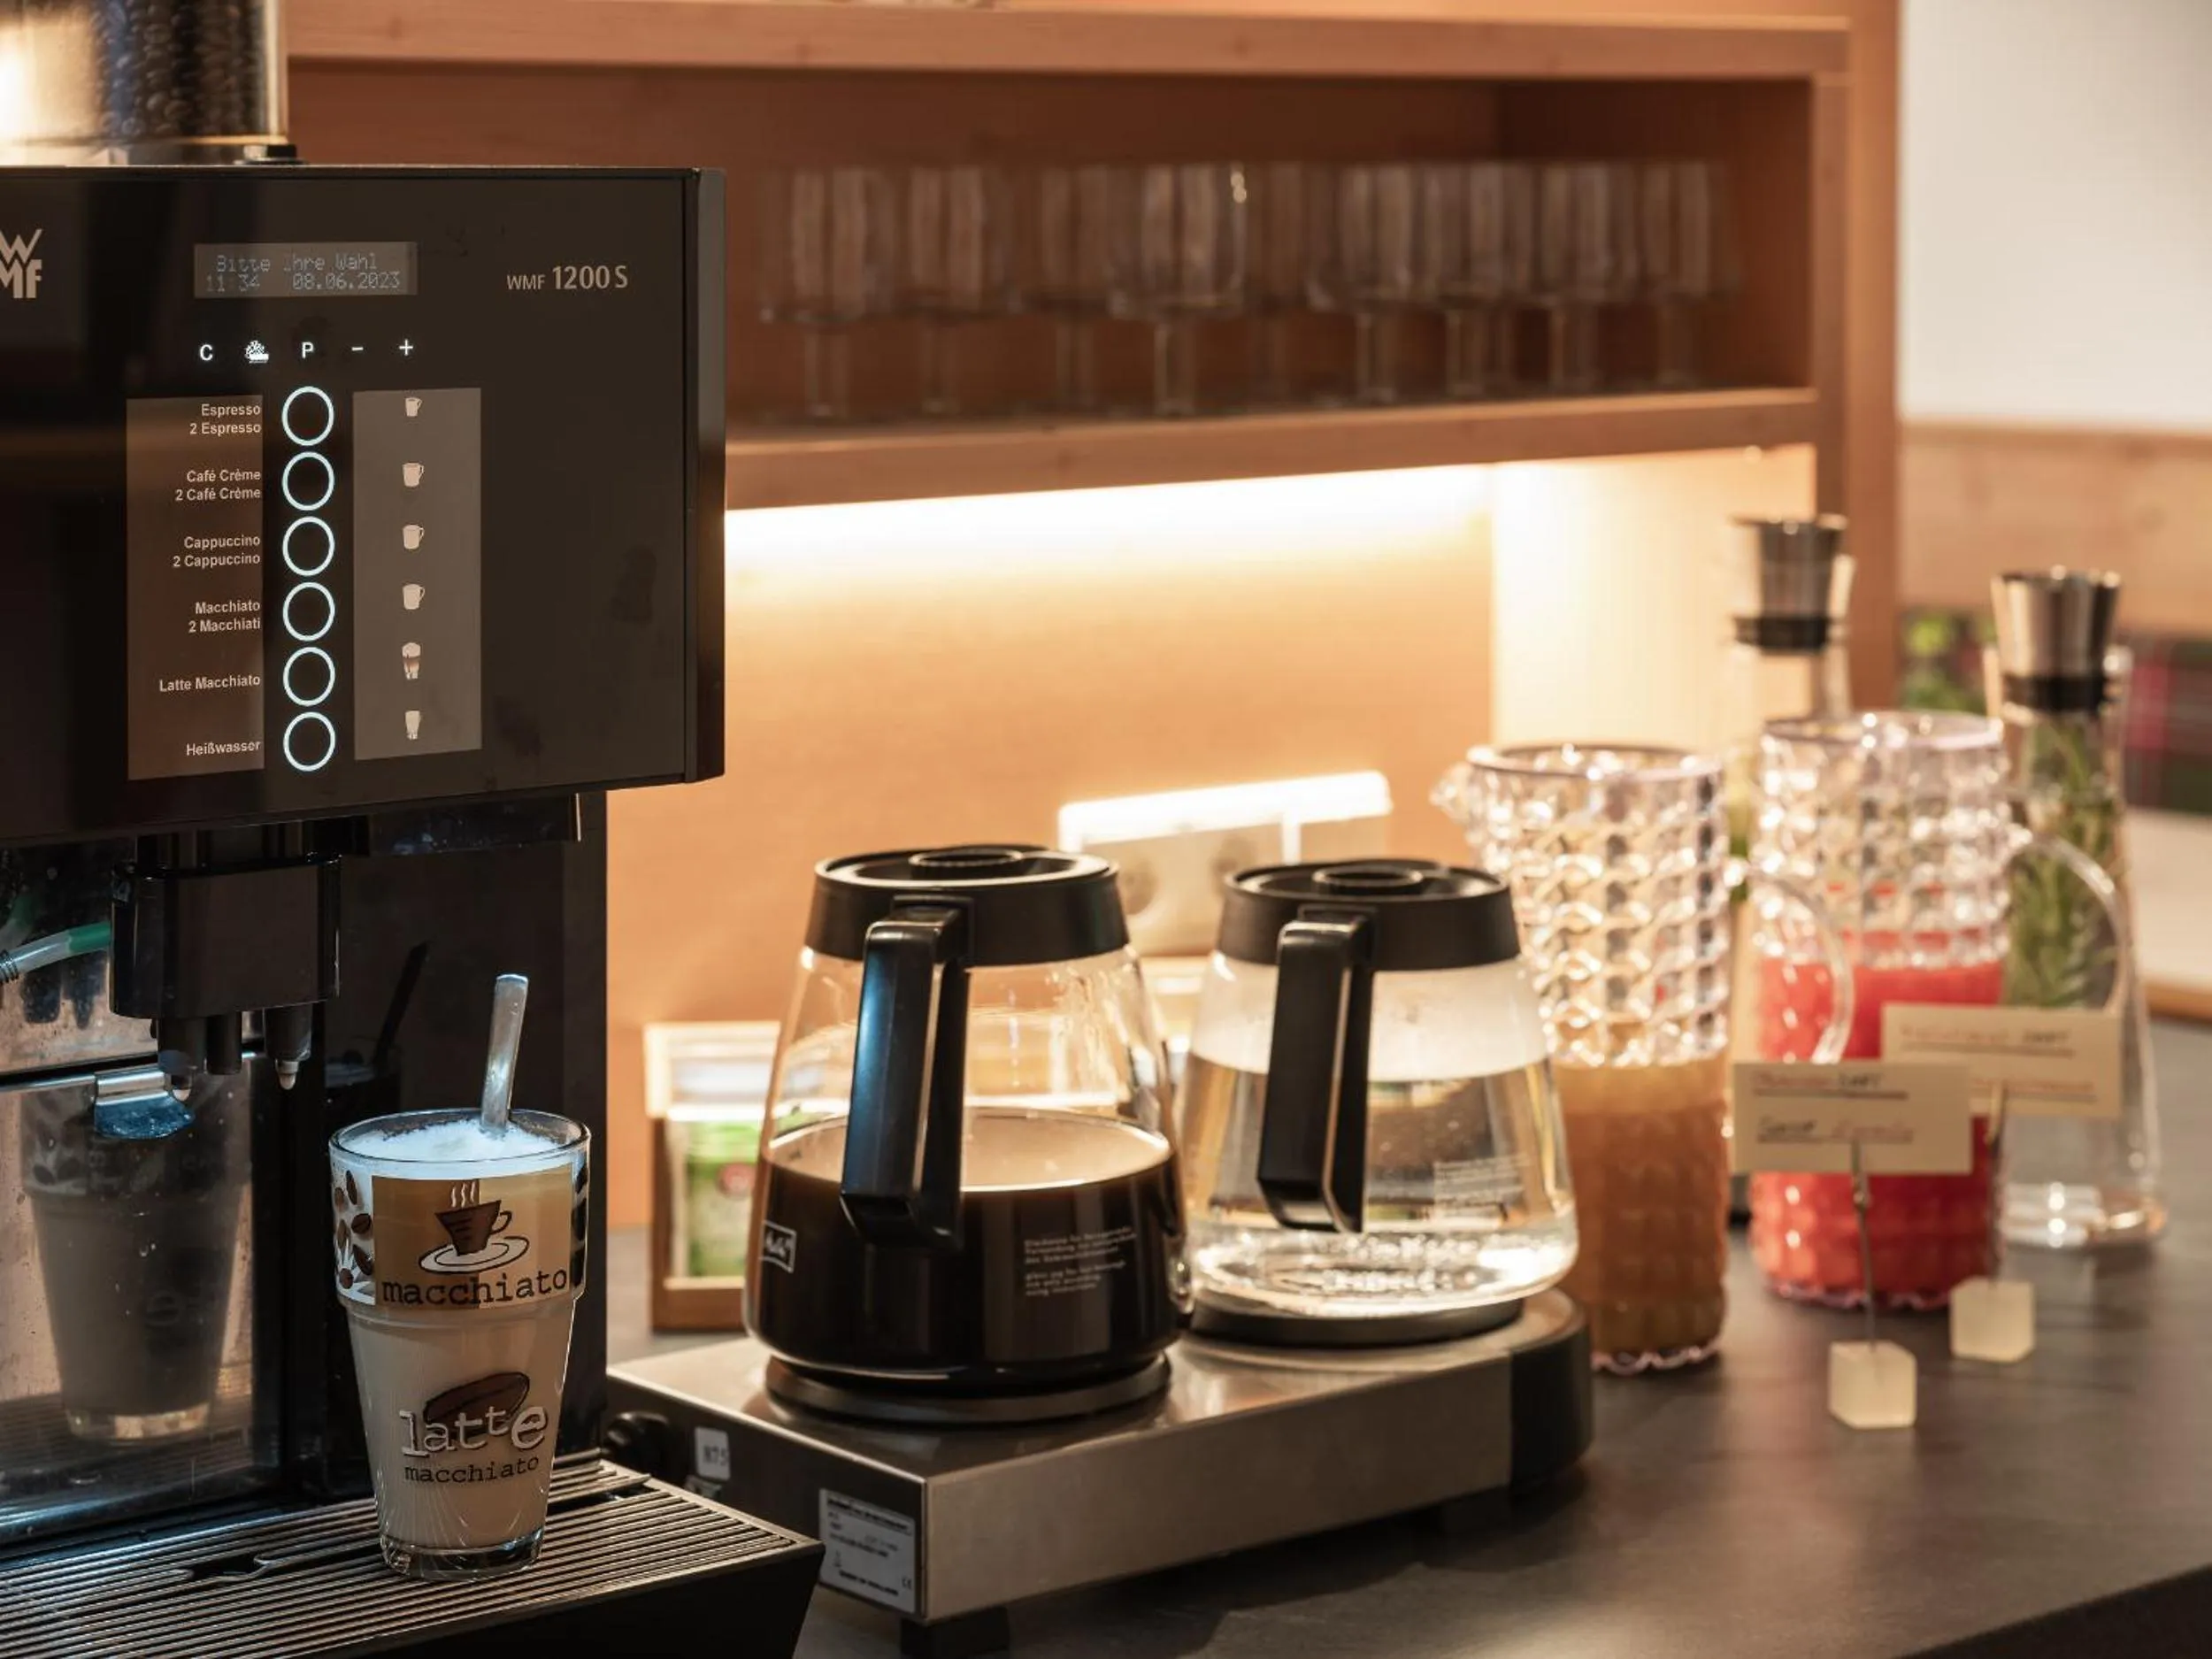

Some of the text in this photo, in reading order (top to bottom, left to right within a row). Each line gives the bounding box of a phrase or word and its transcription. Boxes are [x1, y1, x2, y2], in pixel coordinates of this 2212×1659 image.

[216, 254, 271, 273] Bitte
[335, 251, 378, 270] Wahl
[292, 270, 401, 290] 08.06.2023
[506, 273, 546, 290] WMF
[199, 343, 213, 361] C
[302, 342, 314, 358] P
[201, 403, 262, 419] Espresso
[189, 421, 263, 437] 2 Espresso
[186, 469, 217, 483] Café
[174, 488, 184, 502] 2
[186, 487, 217, 501] Café
[183, 534, 261, 550] Cappuccino
[173, 552, 261, 570] 2 Cappuccino
[195, 599, 261, 615] Macchiato
[188, 617, 261, 634] 2 Macchiati
[158, 674, 261, 692] Latte Macchiato
[186, 741, 262, 757] Heißwasser
[381, 1269, 567, 1307] macchiato
[398, 1405, 549, 1458] latte
[404, 1456, 539, 1484] macchiato
